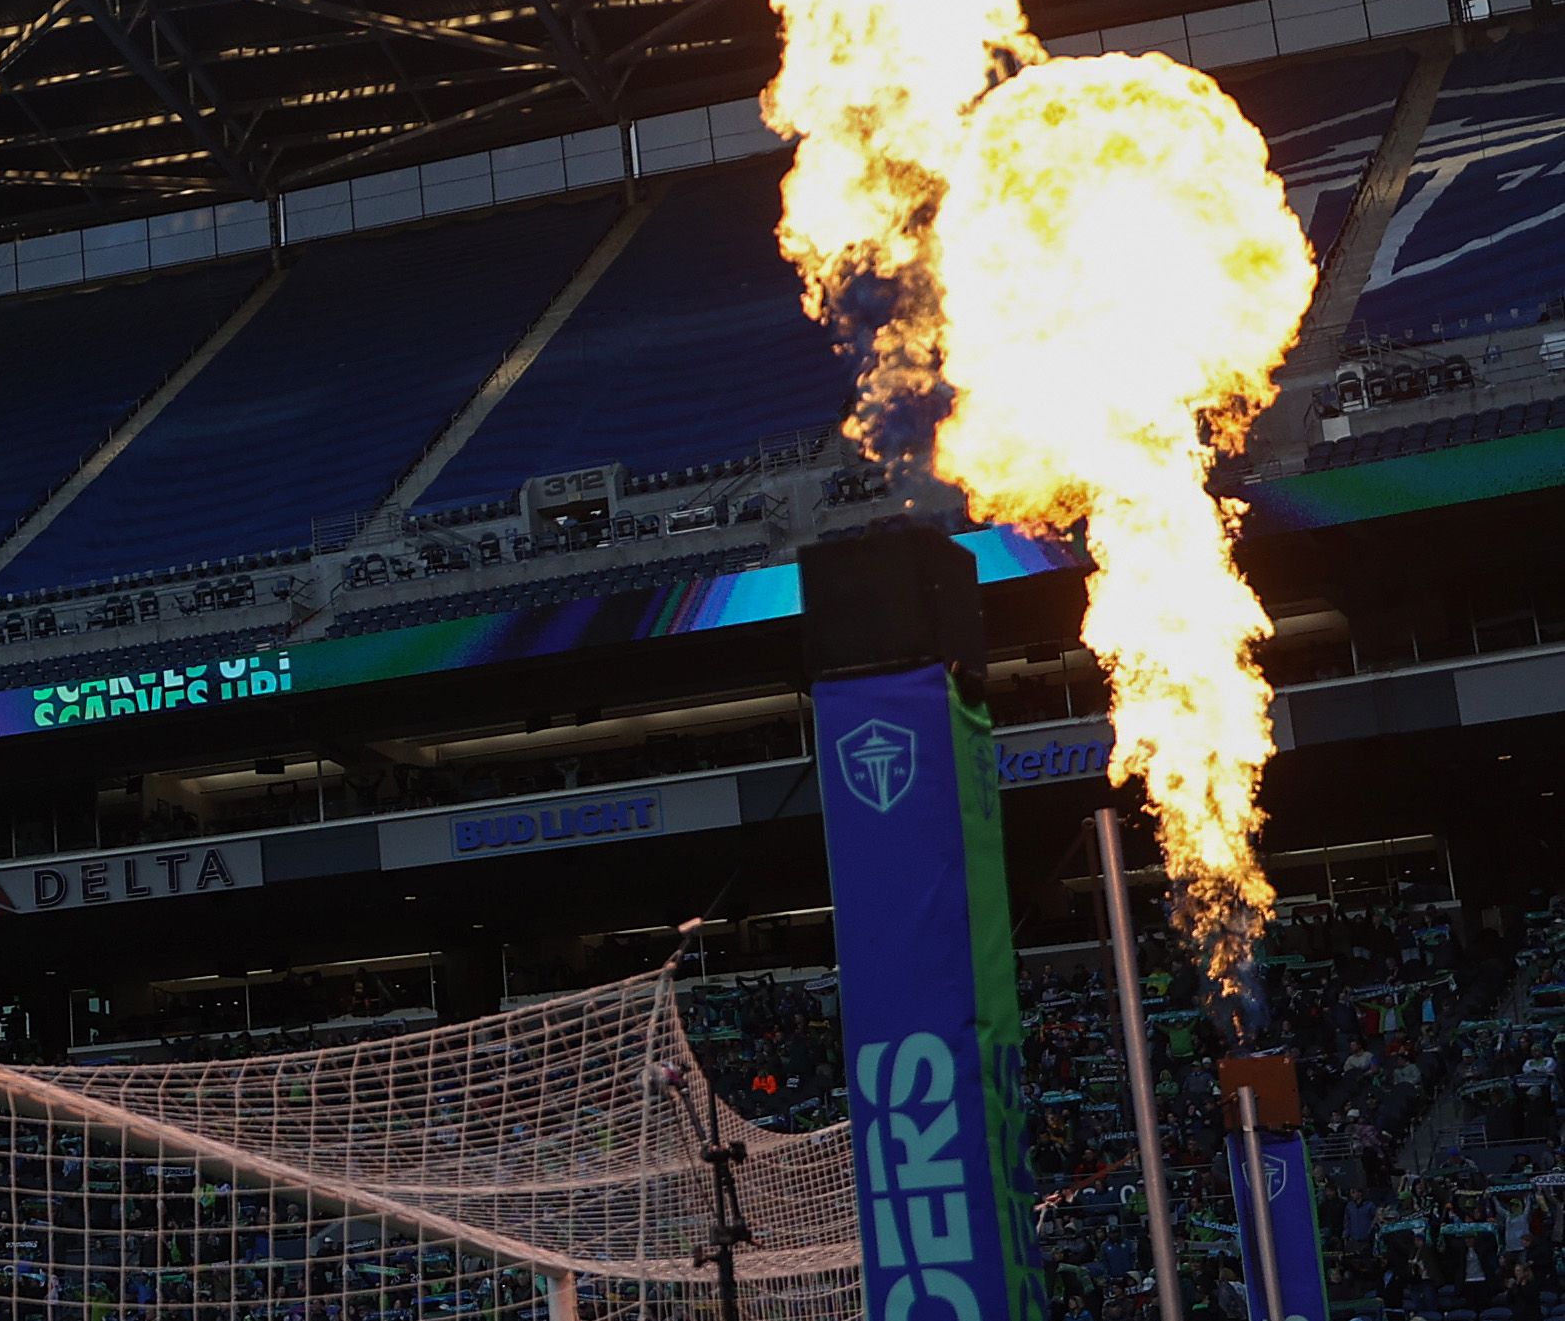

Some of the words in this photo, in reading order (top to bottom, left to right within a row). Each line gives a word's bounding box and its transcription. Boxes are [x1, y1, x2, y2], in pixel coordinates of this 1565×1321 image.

[544, 470, 605, 496] 312
[455, 814, 535, 851] BUD
[540, 797, 655, 840] LIGHT
[34, 847, 234, 908] DELTA
